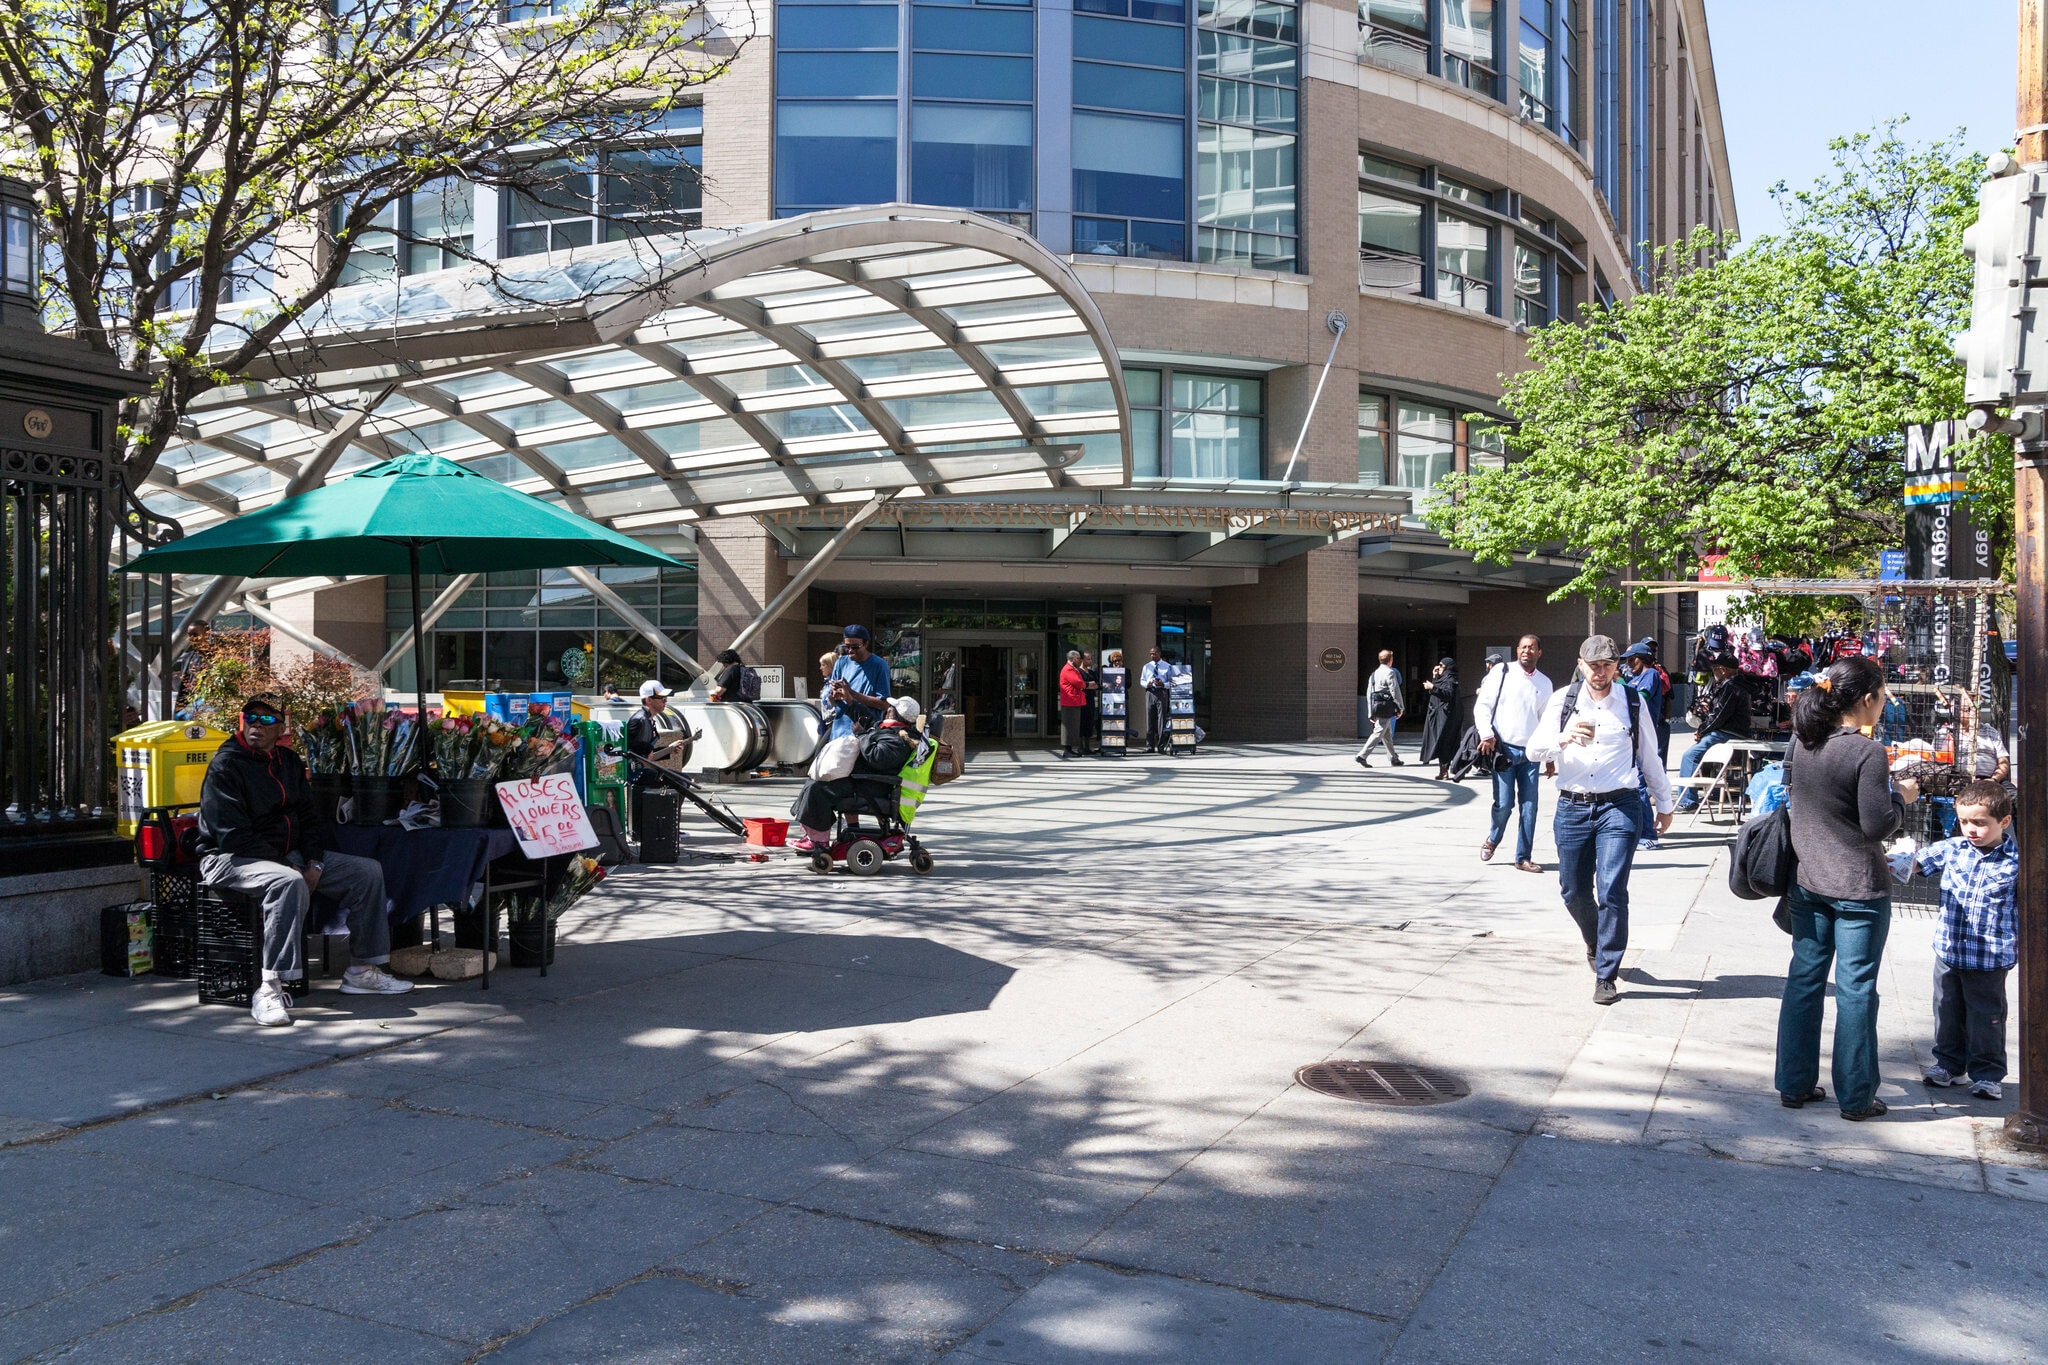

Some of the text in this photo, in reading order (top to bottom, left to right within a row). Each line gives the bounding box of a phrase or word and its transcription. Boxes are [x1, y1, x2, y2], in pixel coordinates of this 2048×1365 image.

[1907, 420, 1950, 472] M
[939, 503, 1124, 526] WASHINGTON
[1132, 505, 1289, 530] UNIVERSITY
[1297, 509, 1408, 533] HOSPITAL
[1931, 504, 1950, 568] Foggy
[186, 752, 208, 763] FREE
[497, 778, 574, 809] ROSES
